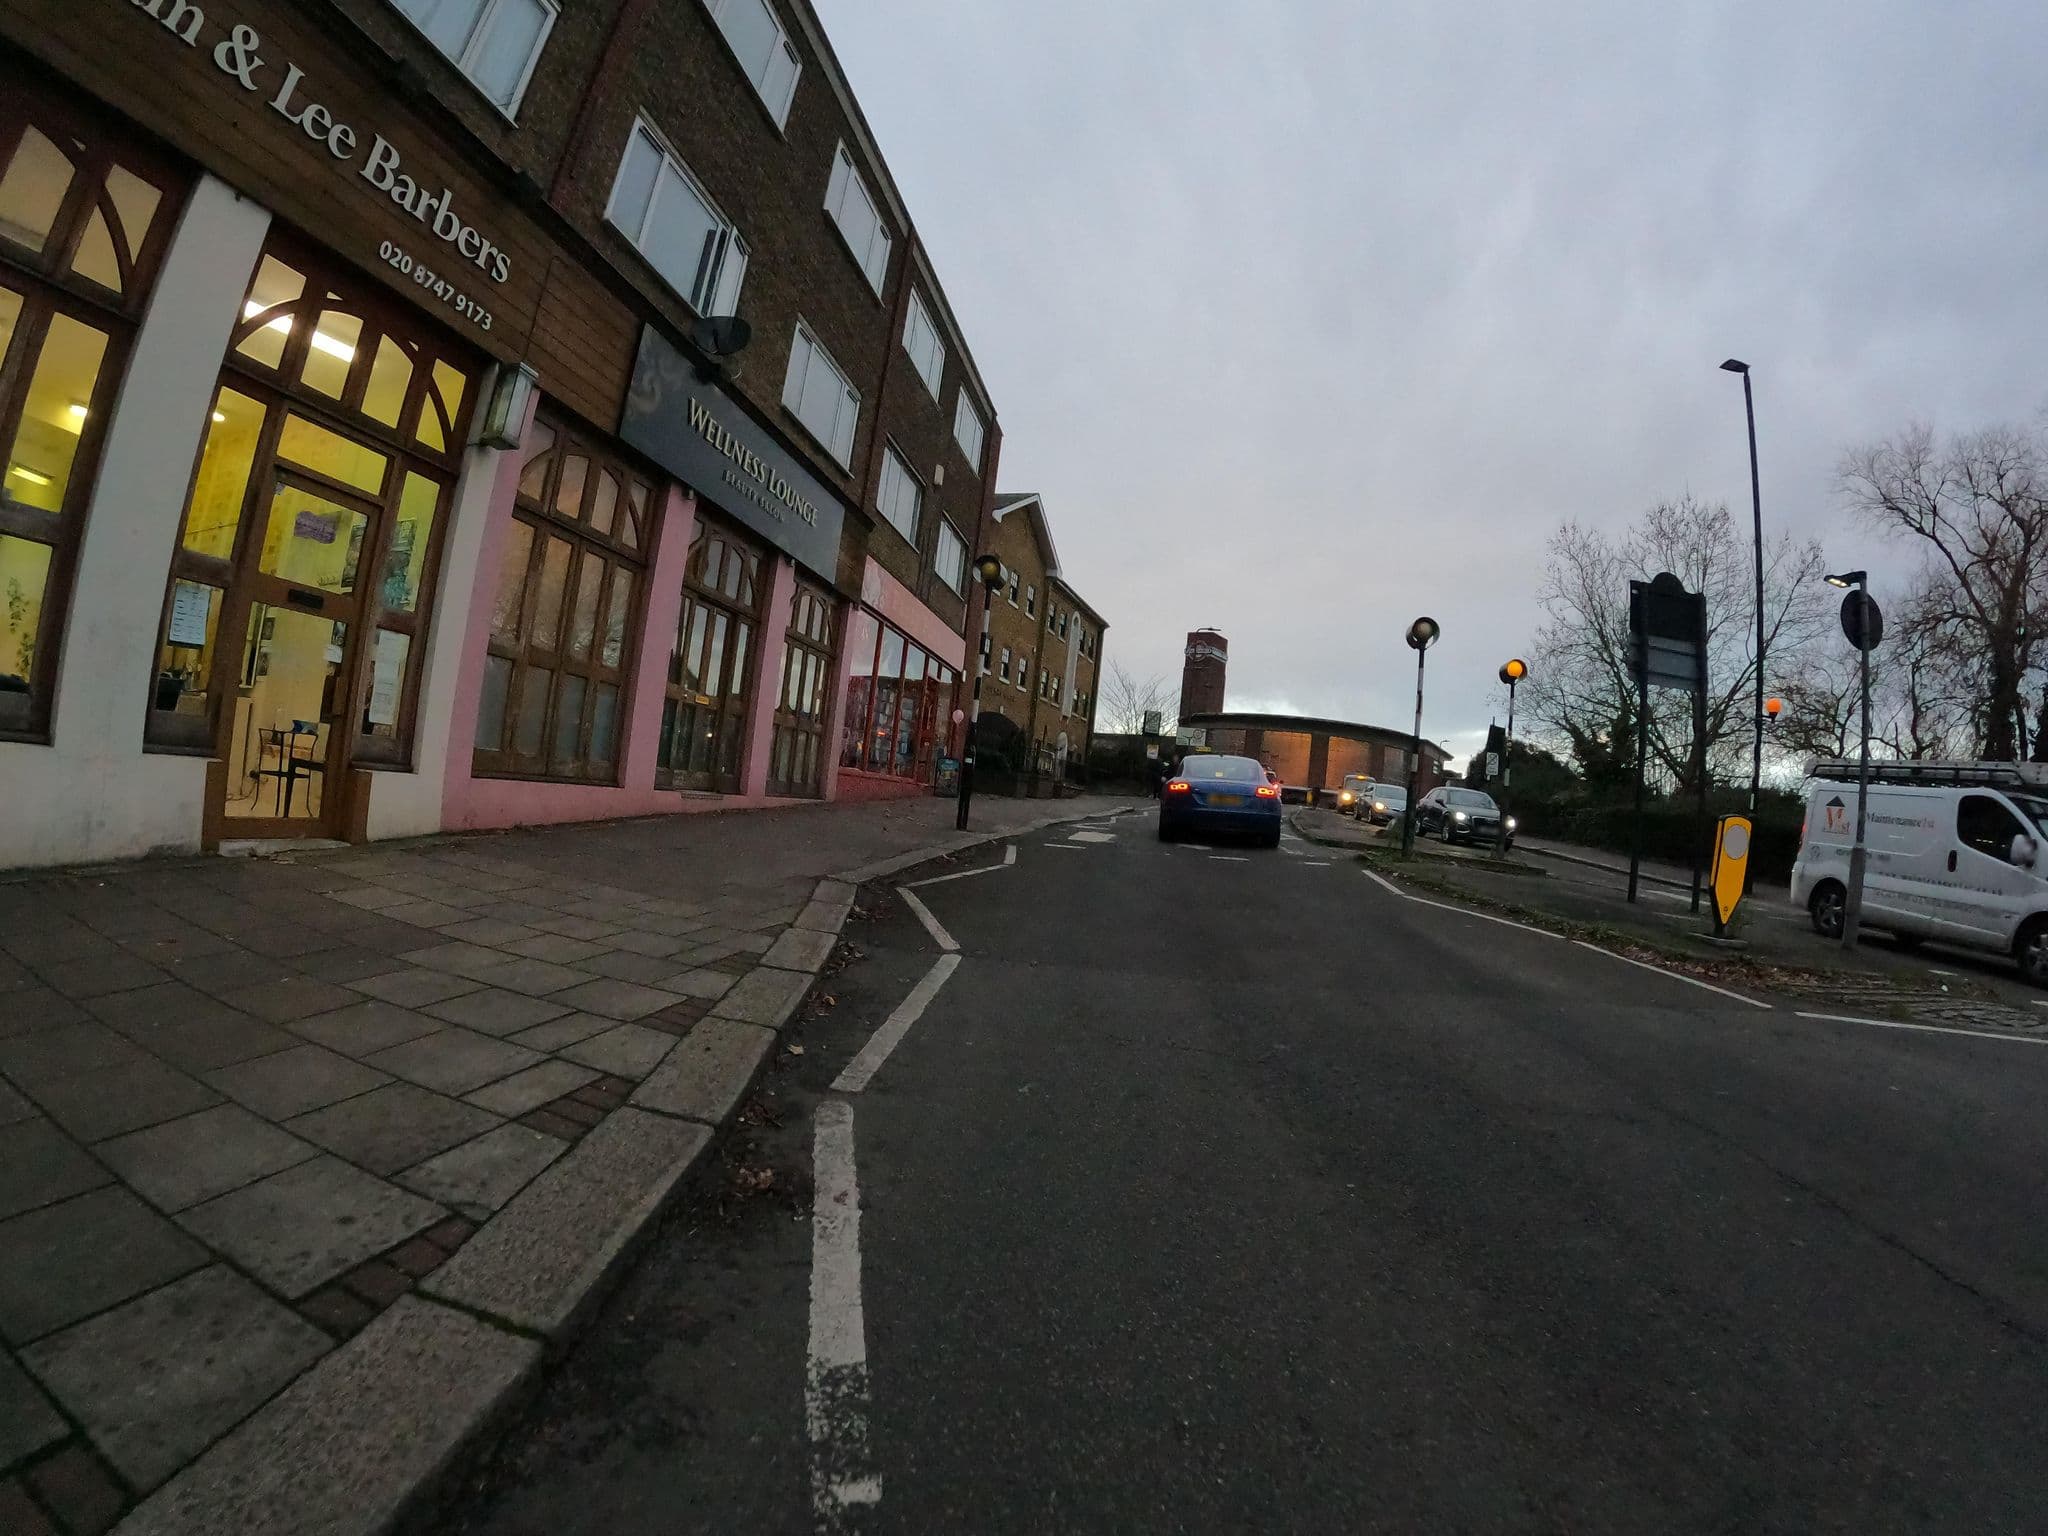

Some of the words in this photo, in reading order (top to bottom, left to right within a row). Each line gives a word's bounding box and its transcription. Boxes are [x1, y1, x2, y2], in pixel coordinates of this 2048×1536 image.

[213, 24, 265, 91] &
[267, 62, 356, 160] Lee
[359, 132, 511, 283] Barbers
[379, 240, 412, 274] 020
[414, 265, 455, 302] 8747
[455, 294, 493, 330] 9173
[689, 395, 767, 484] WELLNESS
[769, 467, 820, 527] LOUNGE
